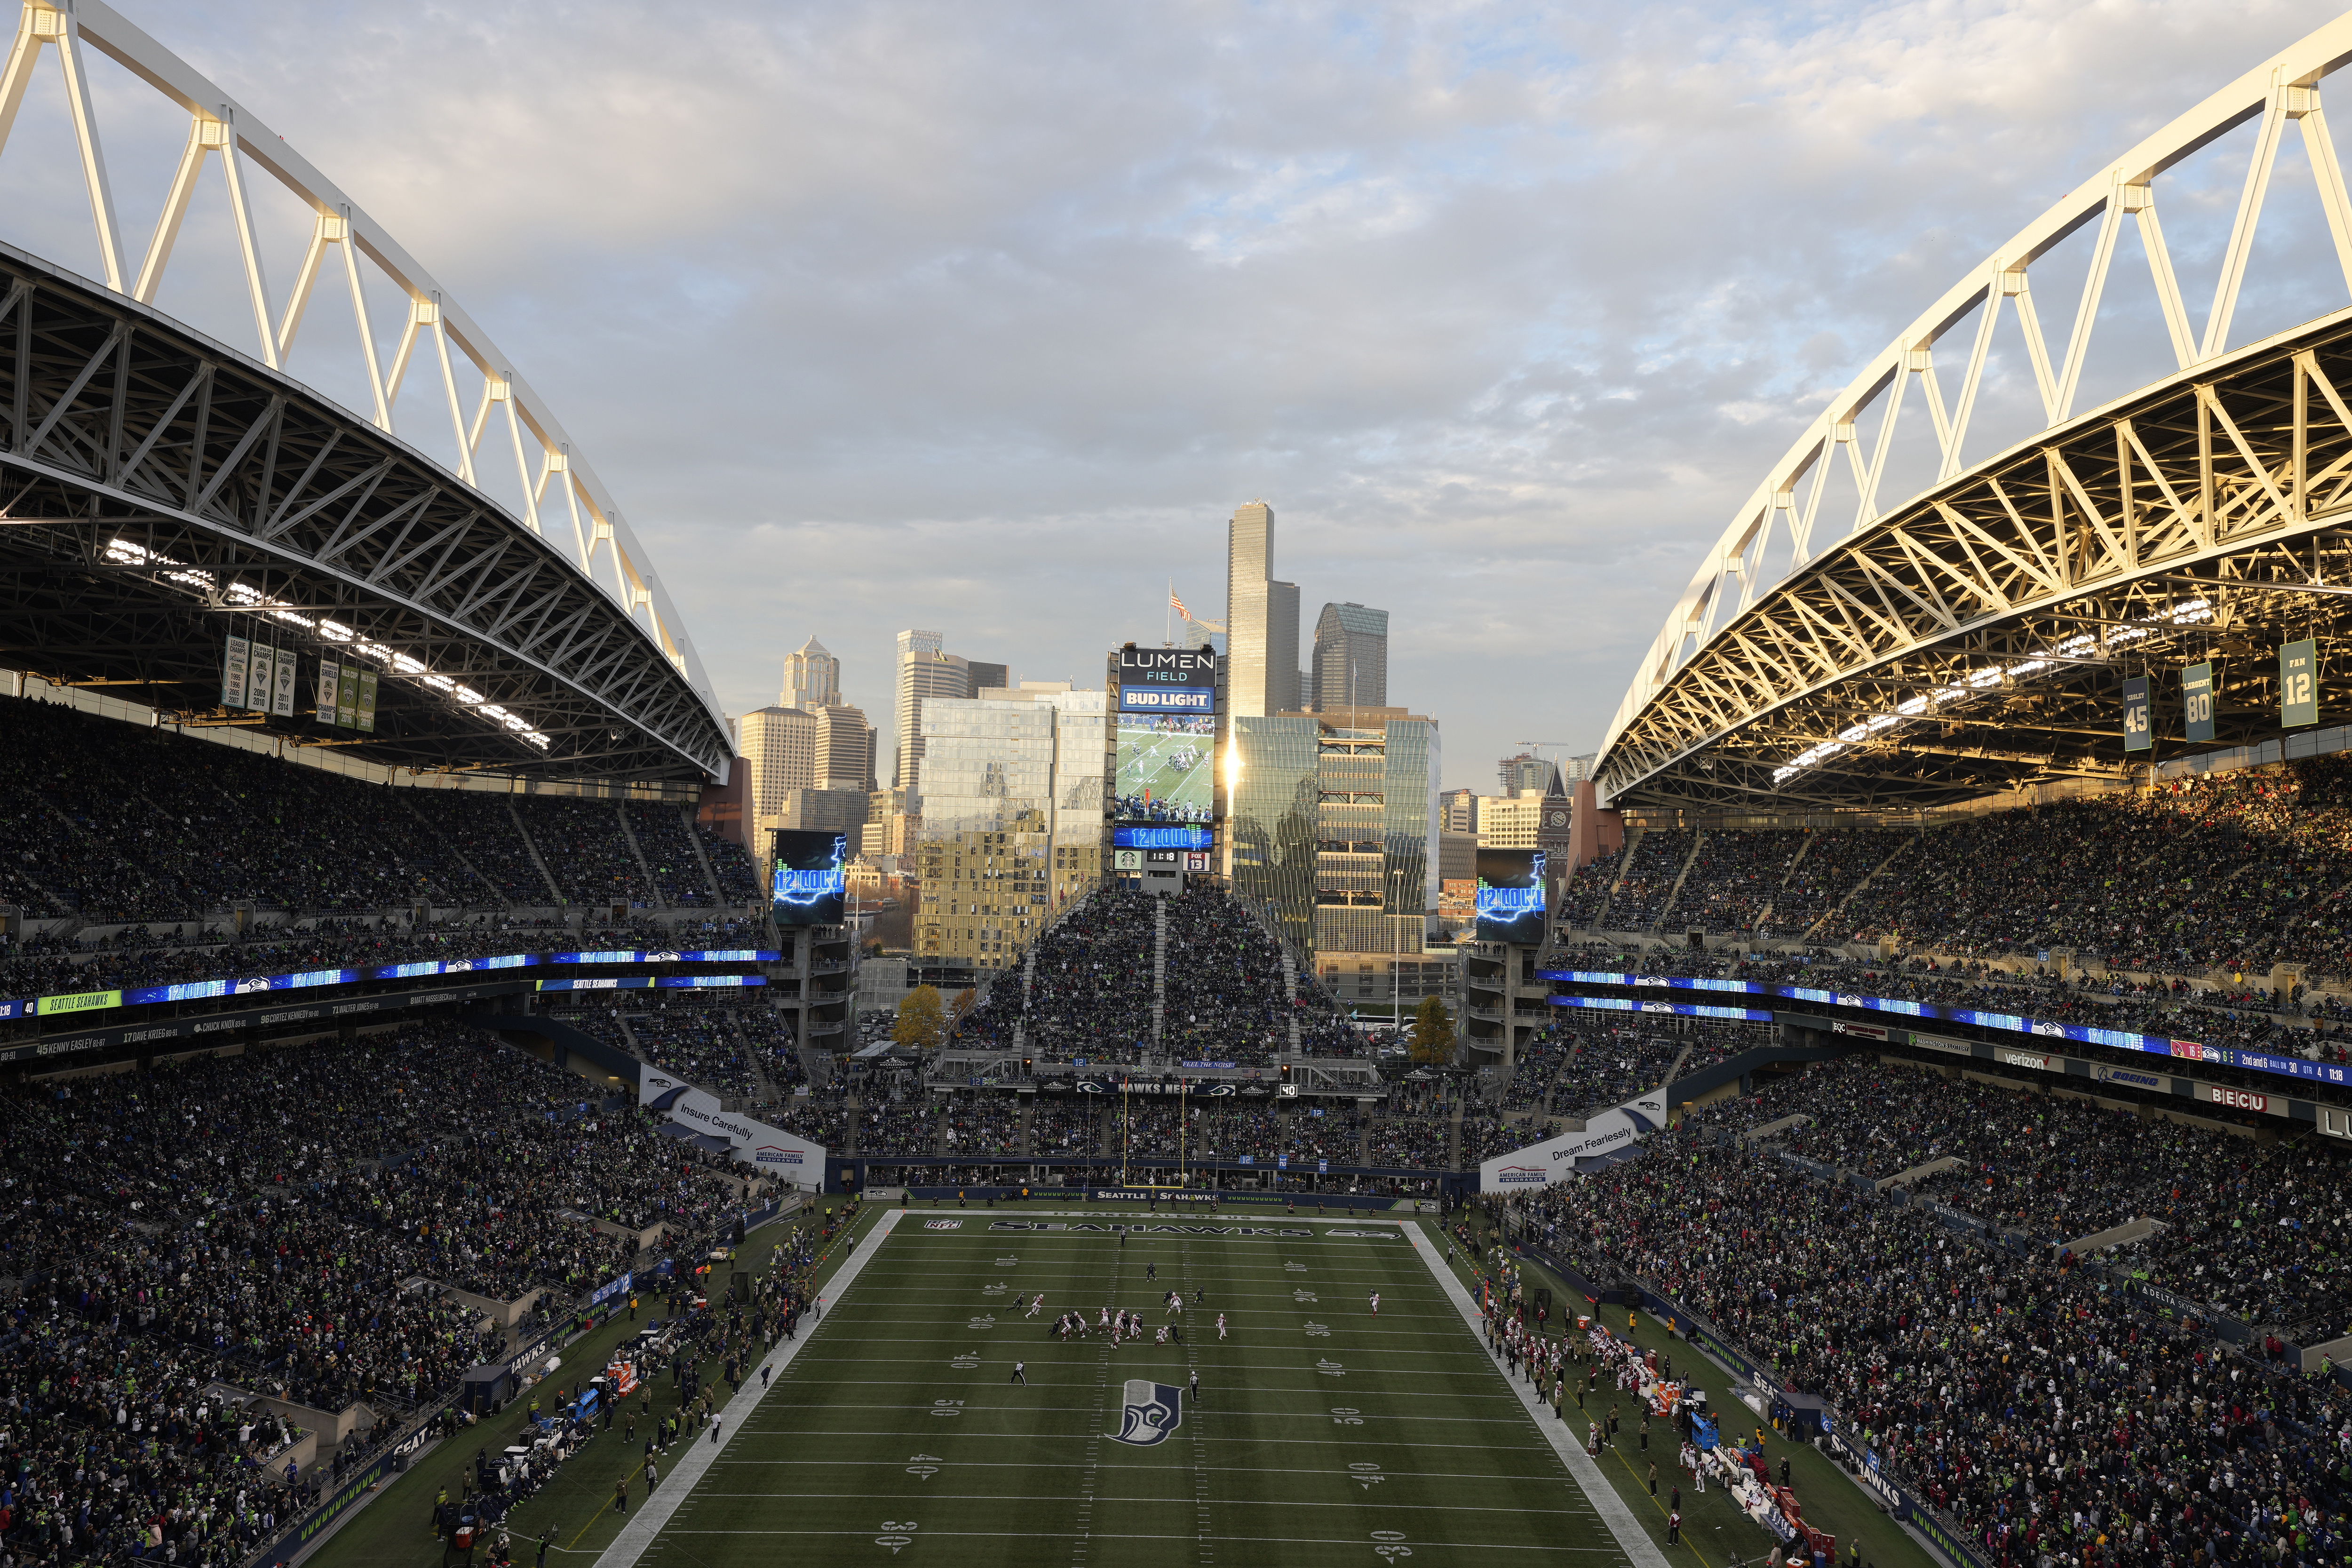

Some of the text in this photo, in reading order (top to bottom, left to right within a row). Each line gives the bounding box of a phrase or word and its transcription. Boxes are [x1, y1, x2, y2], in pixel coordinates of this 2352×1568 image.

[231, 639, 246, 649] LEAGUE
[230, 645, 246, 655] CHAMPS
[254, 650, 271, 661] CHAMPS
[278, 656, 295, 667] CHAMPS
[1121, 653, 1214, 669] LUMEN
[2289, 657, 2306, 668] FAN
[321, 669, 337, 679] SHIELD
[342, 669, 350, 678] MLS
[1147, 671, 1188, 681] FIELD
[2184, 678, 2210, 691] LARGENT
[2286, 673, 2310, 705] 12
[254, 688, 266, 698] 2009
[278, 693, 289, 702] 2011
[1126, 692, 1160, 705] BUD
[2127, 692, 2145, 701] EASLEY
[253, 697, 265, 707] 2010
[278, 702, 288, 711] 2014
[318, 703, 335, 714] CHAMPS
[339, 706, 355, 716] CHAMPS
[359, 709, 374, 719] CHAMPS
[2186, 693, 2210, 724] 80
[341, 714, 352, 724] 2016
[361, 718, 371, 727] 2019
[2125, 705, 2148, 733] 45
[1132, 828, 1190, 847] 12 LOUD
[1156, 852, 1174, 861] 11:18
[1190, 860, 1202, 869] 13
[776, 869, 840, 891] 12 LOUD
[1478, 888, 1541, 908] 12 LOUD
[593, 952, 617, 963] LOUD
[716, 950, 739, 961] LOUD
[2041, 952, 2048, 961] 12
[304, 971, 326, 987] LOUD
[705, 976, 727, 987] LOUD
[1585, 972, 1607, 984] LOUD
[573, 979, 618, 989] SEATTLE SEAHAWKS
[1705, 980, 1729, 991] LOUD
[182, 982, 207, 1000] LOUD
[50, 994, 108, 1011] SEATTLE SEAHAWKS
[425, 993, 449, 1003] HASSELBECK
[24, 1002, 33, 1014] 40
[339, 1004, 356, 1013] WALTER
[357, 1002, 370, 1011] JONES
[1595, 998, 1616, 1010] LOUD
[261, 1015, 270, 1024] 96
[269, 1012, 287, 1023] CORTEZ
[287, 1010, 309, 1020] KENNEDY
[1707, 1007, 1730, 1017] LOUD
[203, 1022, 220, 1032] CHUCK
[221, 1019, 235, 1030] KNOX
[1834, 1022, 1845, 1033] EQC
[123, 1028, 178, 1043] 17 DAVE KRIEG 80-91
[37, 1038, 105, 1055] 45 KENNY EASLEY 81-87
[1916, 1038, 1948, 1049] WASHINGTON'S
[1, 1051, 16, 1061] 80-91
[2189, 1045, 2195, 1057] 16
[2223, 1050, 2227, 1062] 6
[2005, 1052, 2044, 1070] verizon
[2242, 1054, 2343, 1082] 2nd and 6 BALL ON 30 QTR 4 11:18
[2112, 1071, 2160, 1086] BOEING
[1118, 1083, 1195, 1094] HAWKS NEST
[1282, 1086, 1295, 1096] 40
[680, 1104, 753, 1141] Insure Carefully
[1552, 1128, 1630, 1161] Dream Fearlessly
[1279, 1157, 1287, 1167] 12
[1784, 1153, 1799, 1162] DELTA
[1319, 1162, 1327, 1171] 12
[1939, 1206, 1958, 1219] DELTA
[988, 1221, 1314, 1237] SEAHAWKS
[611, 1282, 618, 1294] 12
[621, 1274, 630, 1293] 12
[593, 1291, 600, 1304] 96
[2149, 1288, 2176, 1306] DELTA
[1869, 1452, 1877, 1471] 12
